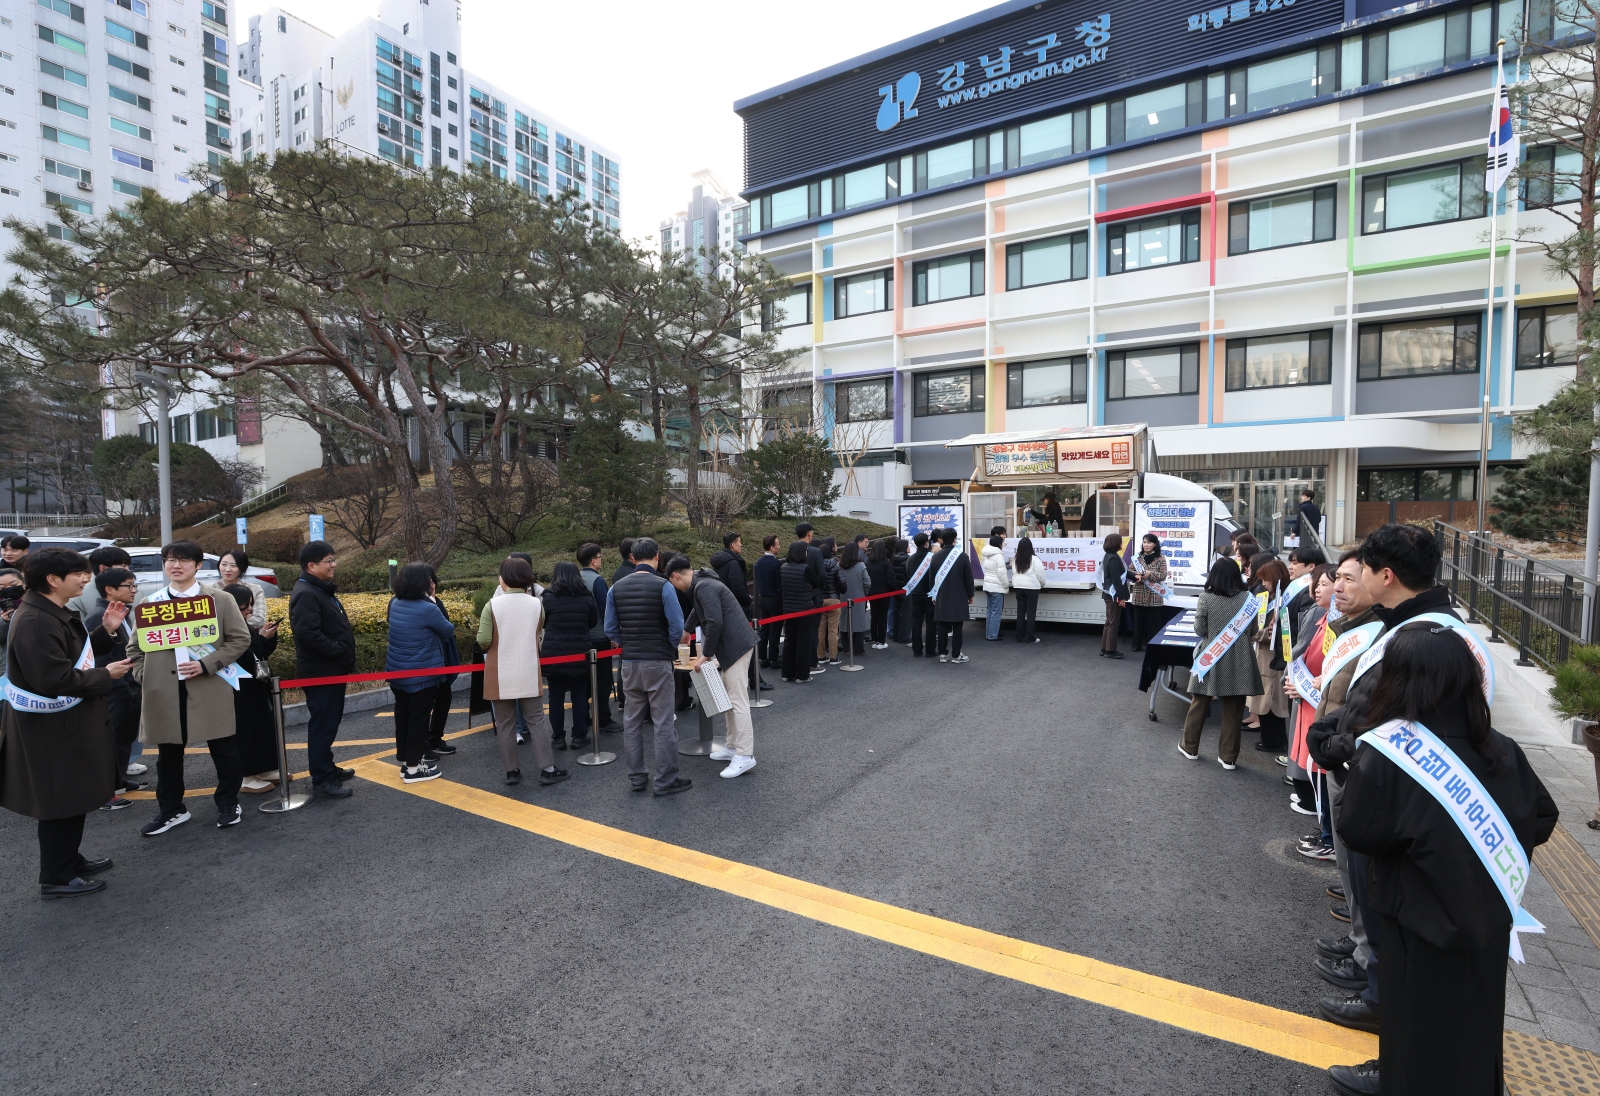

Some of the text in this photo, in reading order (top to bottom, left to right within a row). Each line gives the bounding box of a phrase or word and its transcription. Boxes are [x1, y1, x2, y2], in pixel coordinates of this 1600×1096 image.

[1187, 0, 1296, 32] 학동로 42
[937, 13, 1111, 92] 강남구청
[937, 46, 1109, 109] www.gangnam.go.kr
[336, 115, 356, 134] LOTTE
[1061, 450, 1110, 461] 맛있게드세요
[1147, 507, 1196, 517] 청렴리더 강남
[1057, 559, 1097, 572] 우수등급
[1174, 550, 1194, 558] 오늘도
[140, 597, 211, 624] 부정부패
[146, 626, 190, 647] 척결!
[1209, 632, 1233, 657] 부패
[1389, 725, 1504, 854] 청렴동호회
